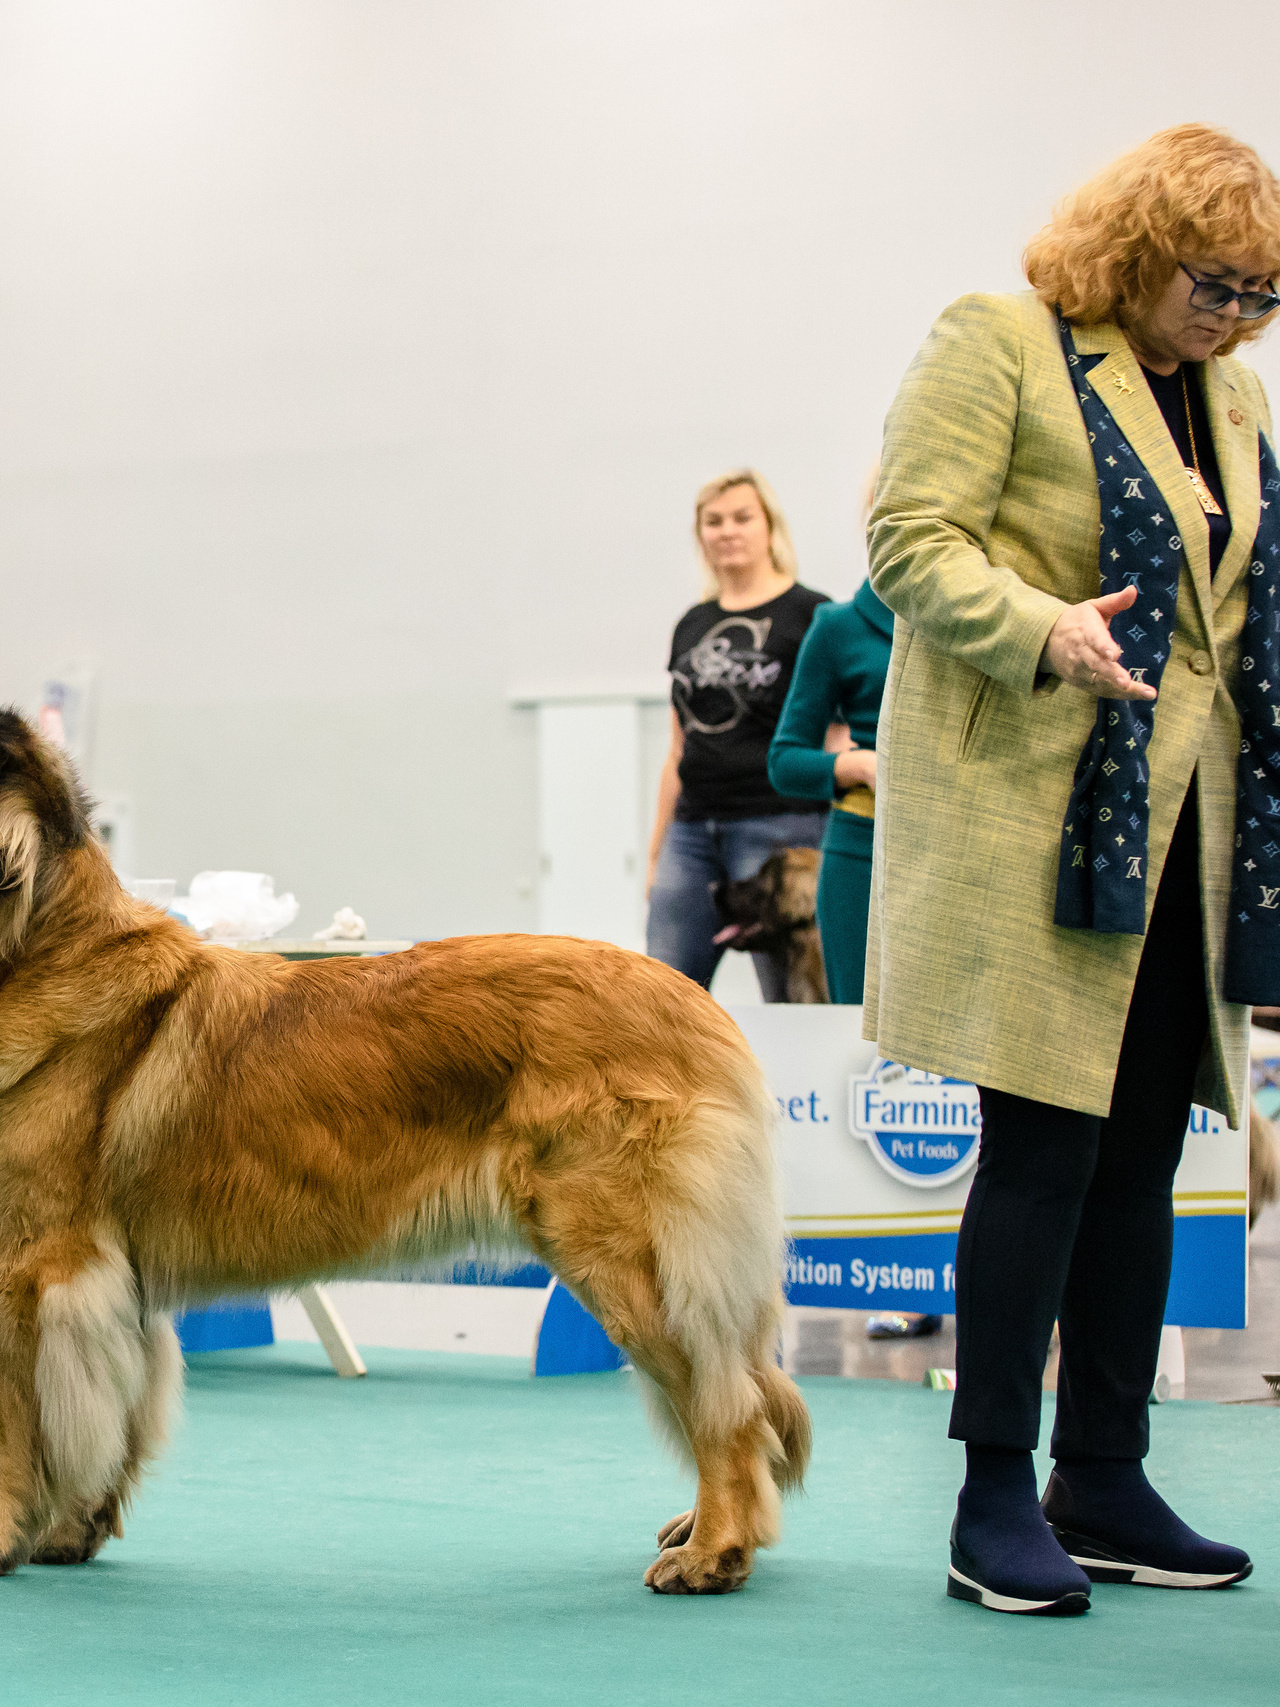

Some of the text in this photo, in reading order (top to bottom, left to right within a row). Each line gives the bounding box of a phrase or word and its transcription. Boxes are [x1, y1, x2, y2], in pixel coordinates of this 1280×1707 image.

[891, 1139, 960, 1160] Pet Foods
[850, 1258, 935, 1295] System
